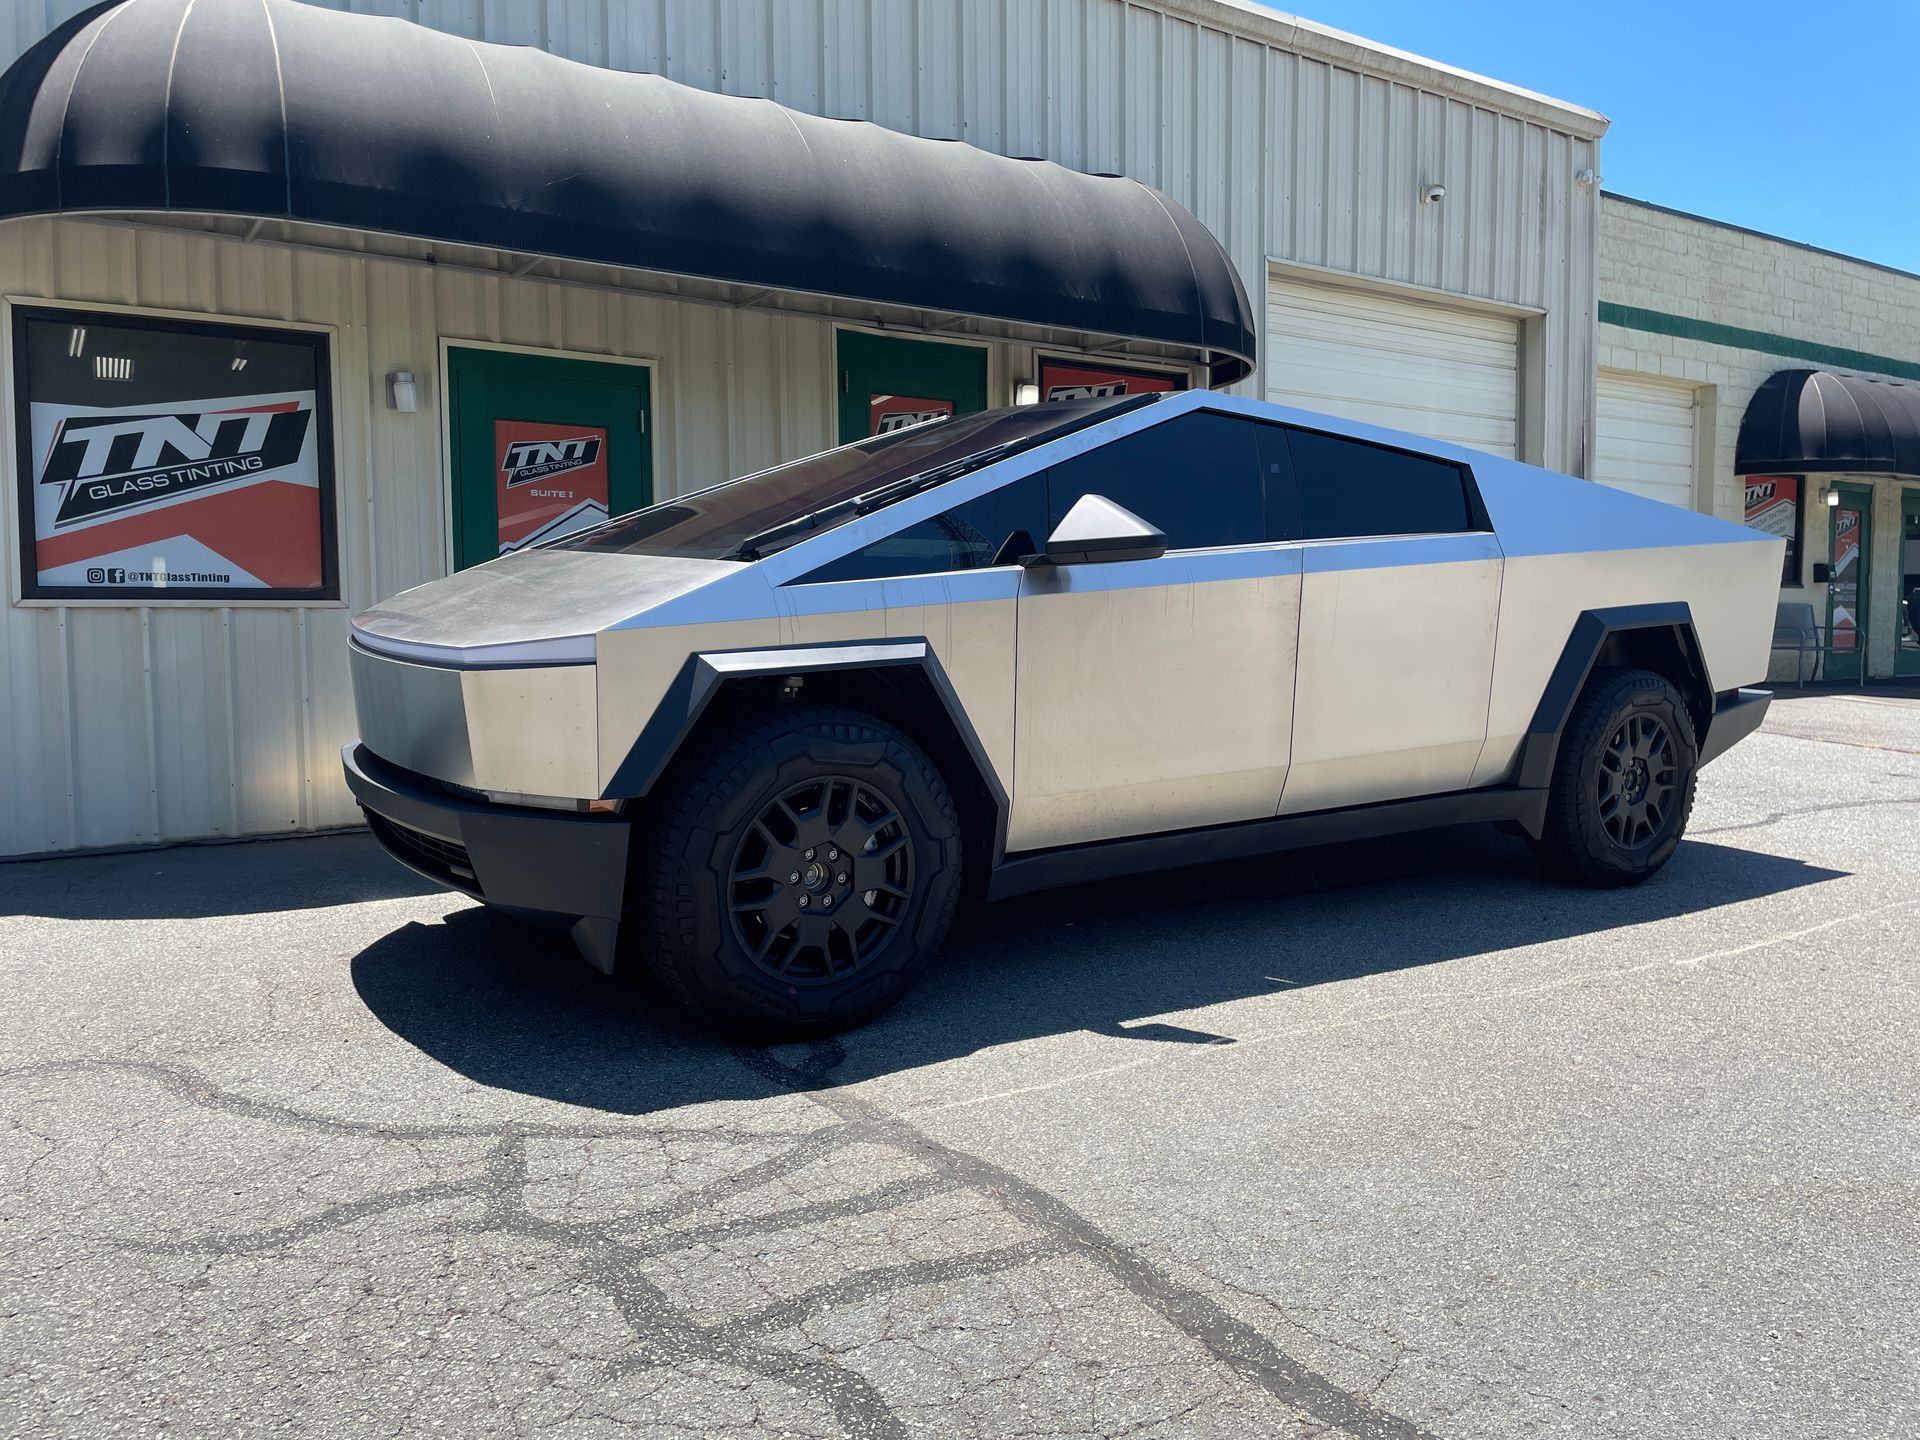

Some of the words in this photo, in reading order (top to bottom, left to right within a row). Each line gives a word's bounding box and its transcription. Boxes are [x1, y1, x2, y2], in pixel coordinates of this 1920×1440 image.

[62, 413, 274, 477] TNT
[511, 441, 586, 467] TNT
[520, 465, 549, 477] GLASS
[550, 458, 583, 469] TINTING
[88, 473, 170, 500] GLASS
[171, 456, 263, 483] TINTING
[530, 489, 566, 498] SUITE
[1745, 484, 1772, 503] TNT
[1837, 516, 1855, 532] TNT
[128, 572, 230, 583] @TNTGlassTinting
